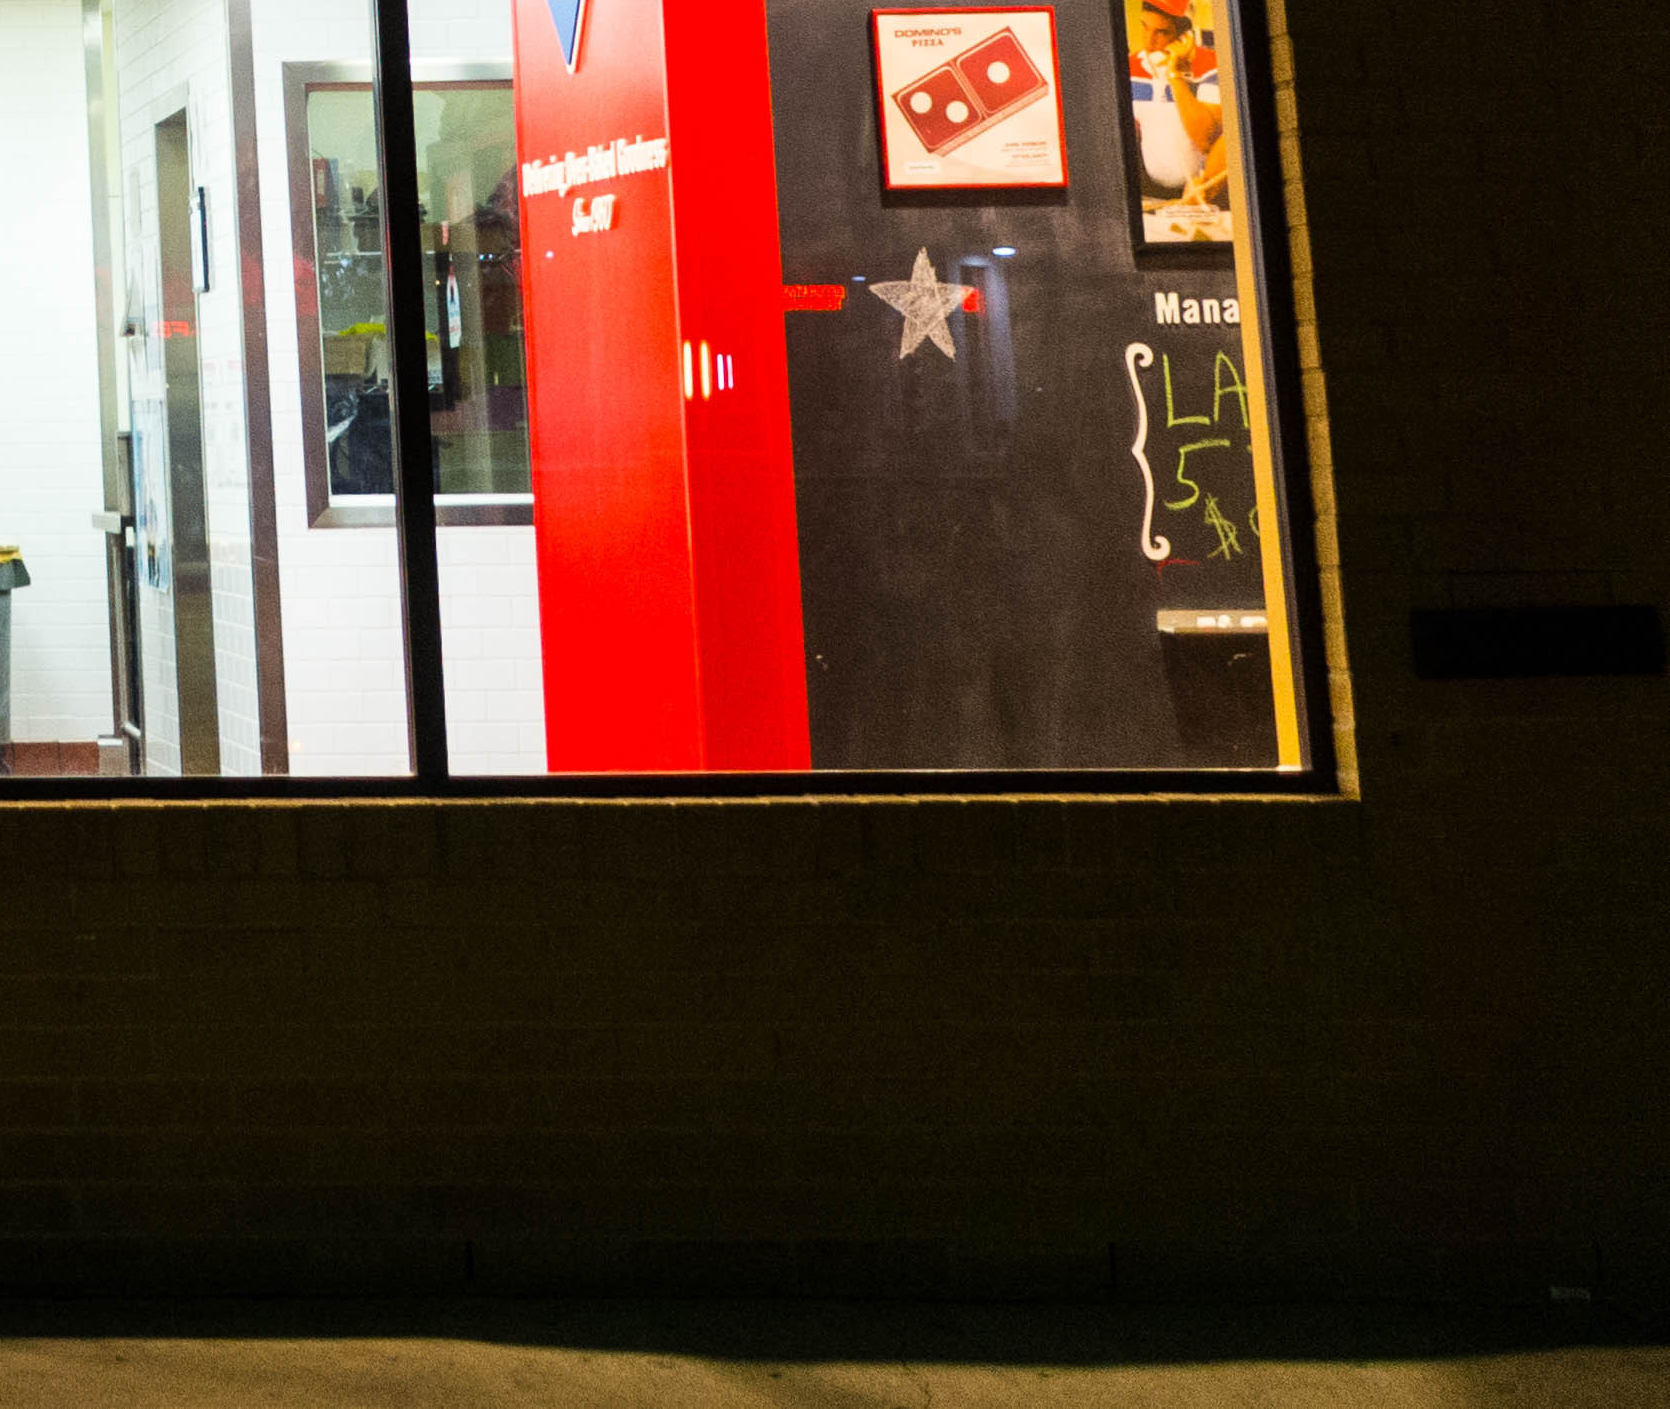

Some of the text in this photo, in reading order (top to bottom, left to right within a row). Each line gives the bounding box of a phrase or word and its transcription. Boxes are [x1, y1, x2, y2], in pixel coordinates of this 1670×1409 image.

[894, 26, 962, 38] DOMINO'S
[911, 38, 944, 48] PIZZA
[1154, 292, 1242, 325] Mana
[1162, 350, 1250, 429] LA
